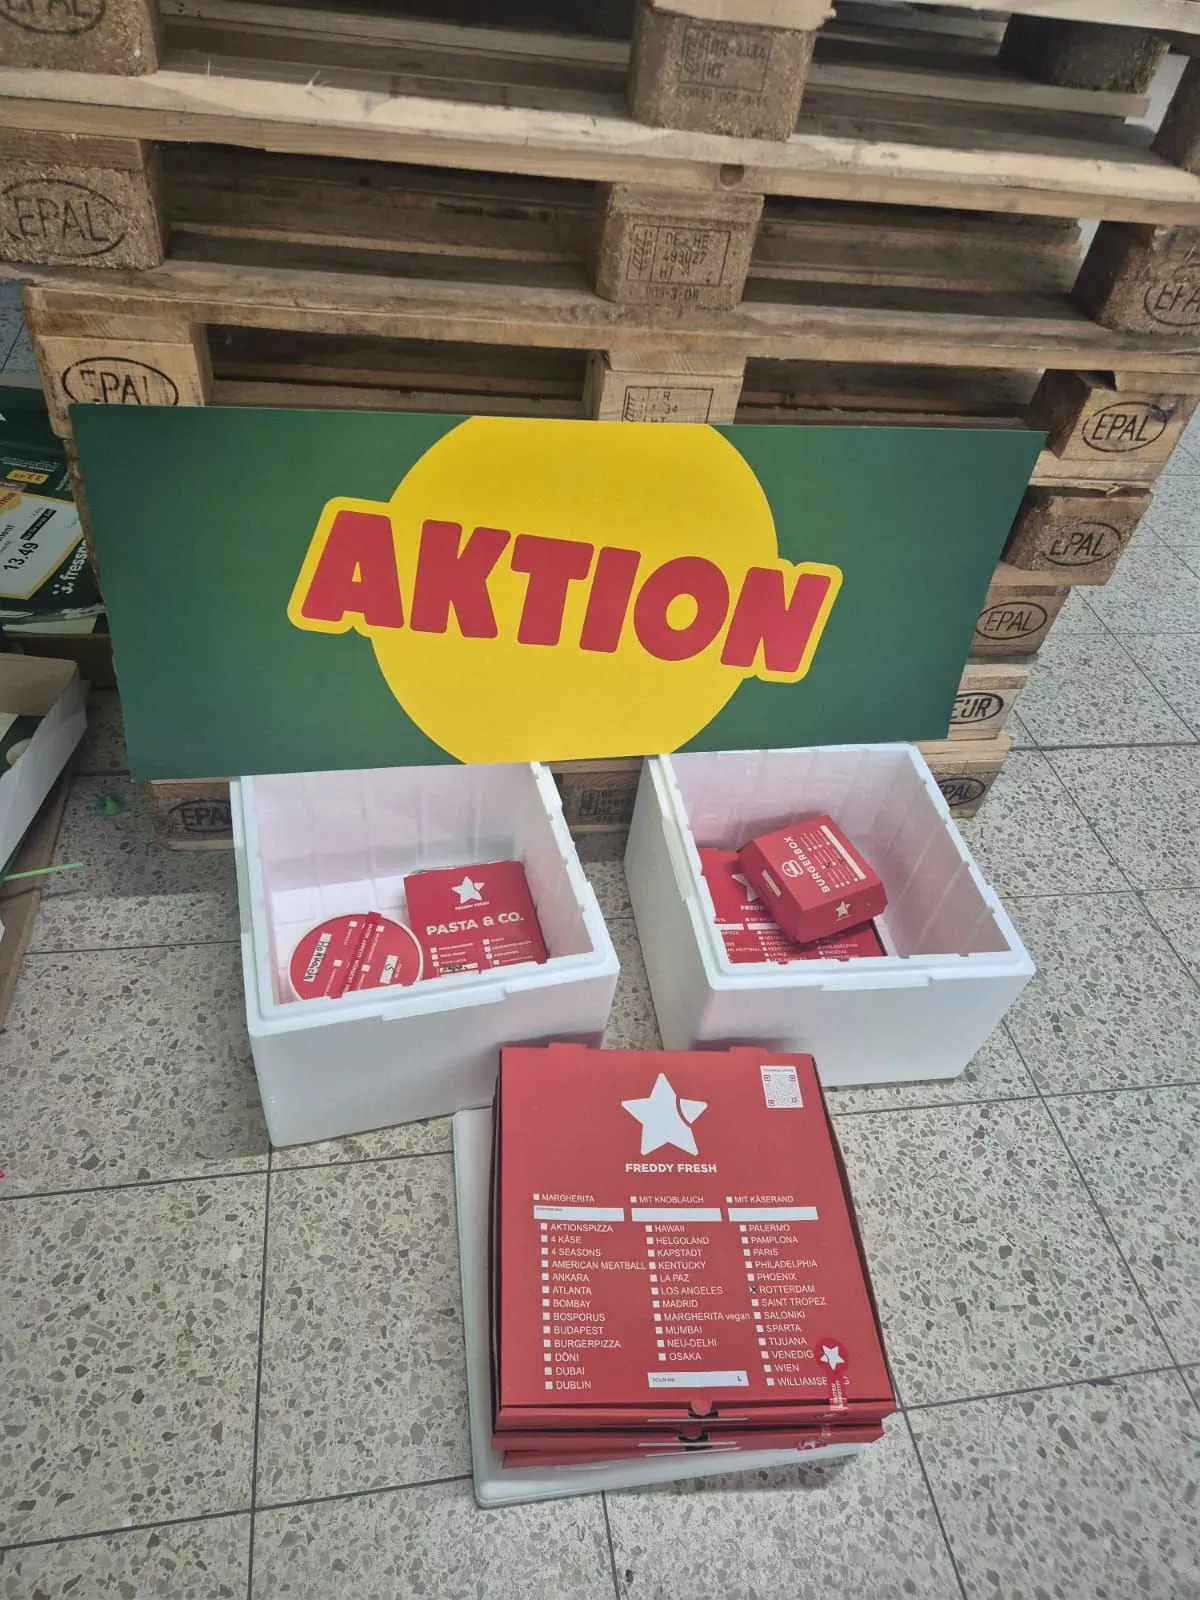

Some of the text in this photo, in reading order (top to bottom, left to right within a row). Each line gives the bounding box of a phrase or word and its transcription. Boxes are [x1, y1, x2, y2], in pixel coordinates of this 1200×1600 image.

[14, 199, 109, 243] EPAL
[1091, 413, 1149, 442] EPAL
[1050, 531, 1104, 557] EPAL
[3, 542, 39, 571] 13.49
[301, 510, 832, 673] AKTION
[984, 611, 1034, 632] EPAL
[950, 697, 993, 718] EUR
[939, 783, 973, 800] PAL
[784, 836, 832, 894] BURGERBOX
[426, 911, 524, 935] PASTA & CO.
[625, 1163, 718, 1173] FREDDY FRESH
[541, 1193, 595, 1203] MARGHERITA
[639, 1196, 704, 1204] MIT KNOBLAUCH
[734, 1195, 794, 1204] MIT KÄSERAND
[550, 1223, 613, 1233] AKTIONSPIZZA
[654, 1224, 685, 1233] HAWAII
[749, 1224, 790, 1232] PALERMO
[551, 1234, 582, 1244] 4 KÄSE
[656, 1236, 709, 1245] HELGOLAND
[751, 1236, 799, 1244] PAMPLONA
[551, 1248, 601, 1257] 4 SEASONS
[657, 1248, 702, 1257] KAPSTADT
[753, 1248, 779, 1256] PARIS
[551, 1261, 646, 1270] AMERICAN MEATBALL
[658, 1261, 706, 1270] KENTUCKY
[755, 1260, 818, 1269] PHILADELPHIA
[552, 1274, 590, 1282] ANKARA
[660, 1274, 690, 1282] LA PAZ
[757, 1273, 798, 1281] PHOENIX
[552, 1286, 592, 1295] ATLANTA
[660, 1286, 723, 1295] LOS ANGELES
[759, 1285, 816, 1294] ROTTERDAM
[553, 1299, 591, 1308] BOMBAY
[662, 1299, 698, 1308] MADRID
[762, 1297, 827, 1307] SAINT TROPEZ
[553, 1312, 606, 1322] BOSPORUS
[664, 1312, 750, 1322] MARGHERITA vegan
[764, 1311, 806, 1320] SALONIKI
[553, 1326, 604, 1335] BUDAPEST
[665, 1325, 703, 1335] MUMBAI
[766, 1324, 802, 1332] SPARTA
[554, 1339, 621, 1349] BURGERPIZZA
[667, 1338, 717, 1348] NEU-DELHI
[768, 1337, 807, 1346] TIJUANA
[555, 1351, 579, 1362] DÖNI
[669, 1352, 702, 1361] OSAKA
[771, 1350, 814, 1359] VENEDIG
[555, 1366, 585, 1376] DUBAI
[774, 1364, 800, 1372] WIEN
[556, 1380, 592, 1390] DUBLIN
